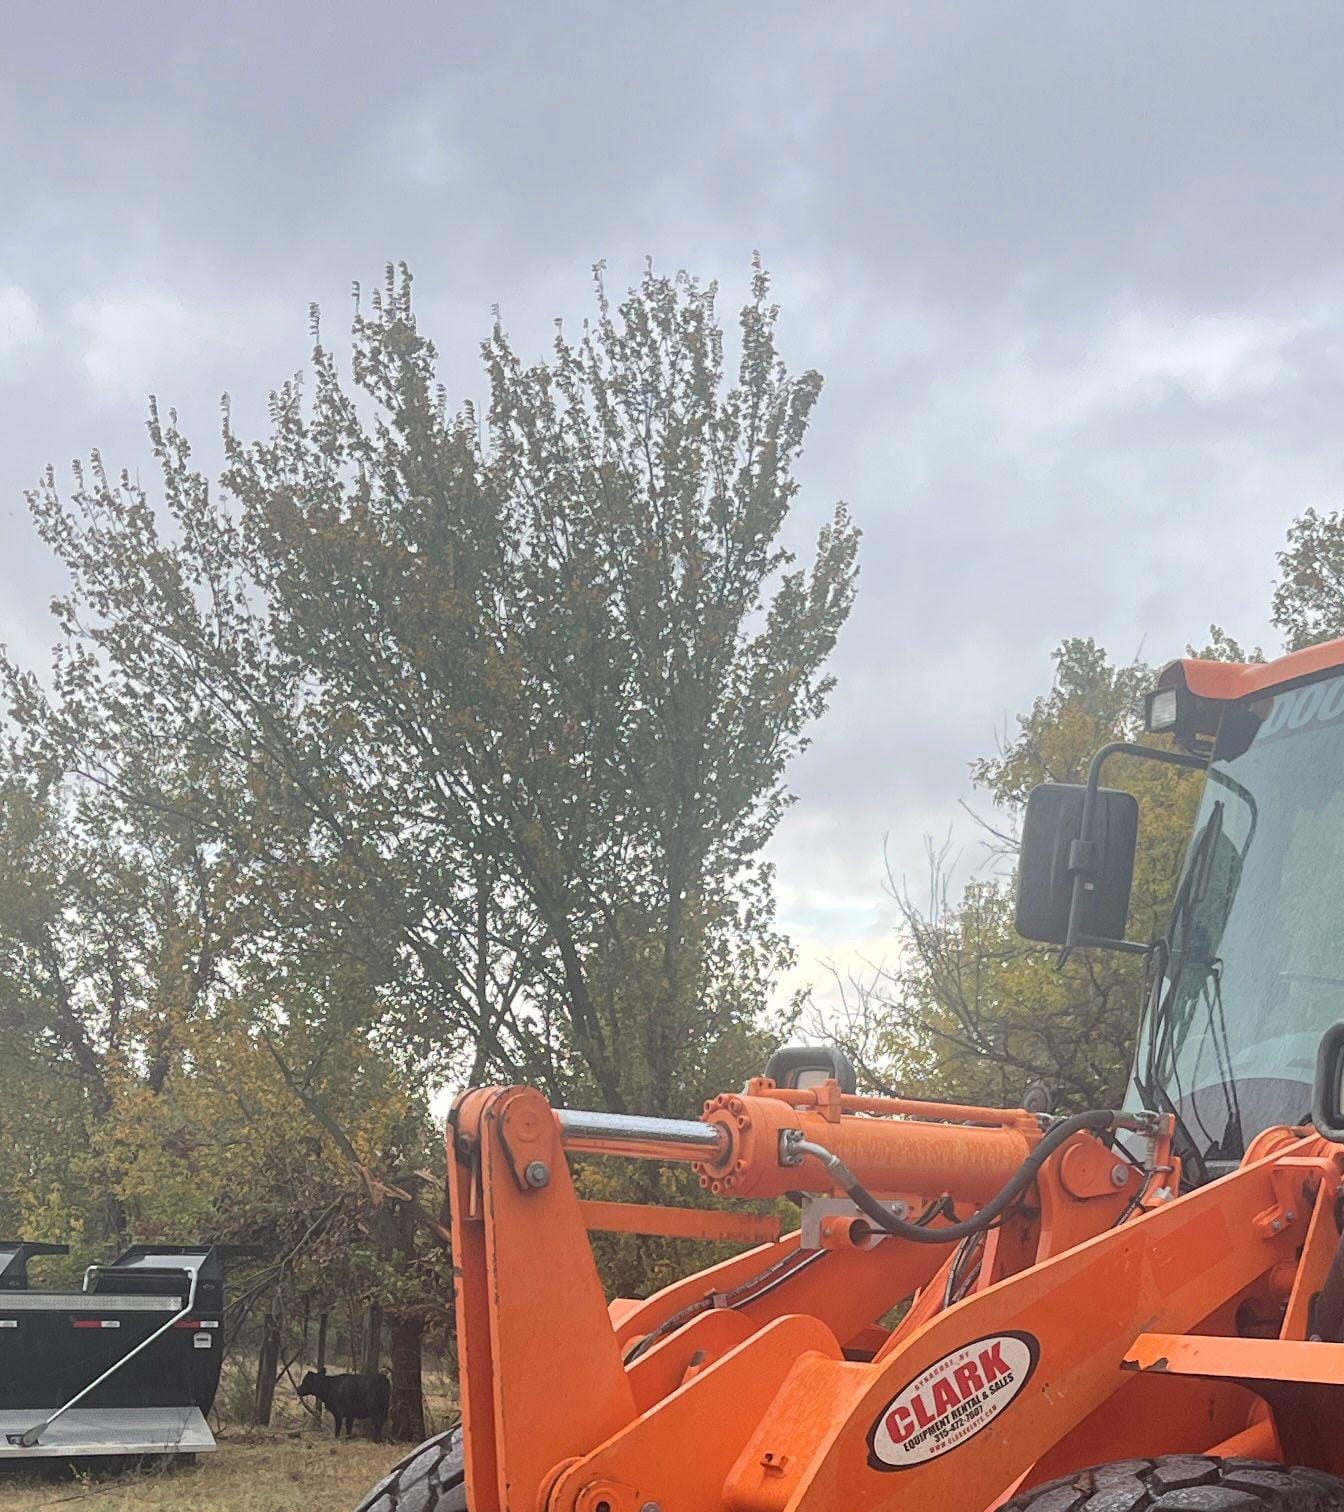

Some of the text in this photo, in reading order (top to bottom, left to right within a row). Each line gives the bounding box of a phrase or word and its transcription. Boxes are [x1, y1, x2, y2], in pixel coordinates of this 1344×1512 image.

[885, 1341, 1011, 1444] CLARK
[903, 1372, 1015, 1452] EQUIPMENT RENTAL & SALES
